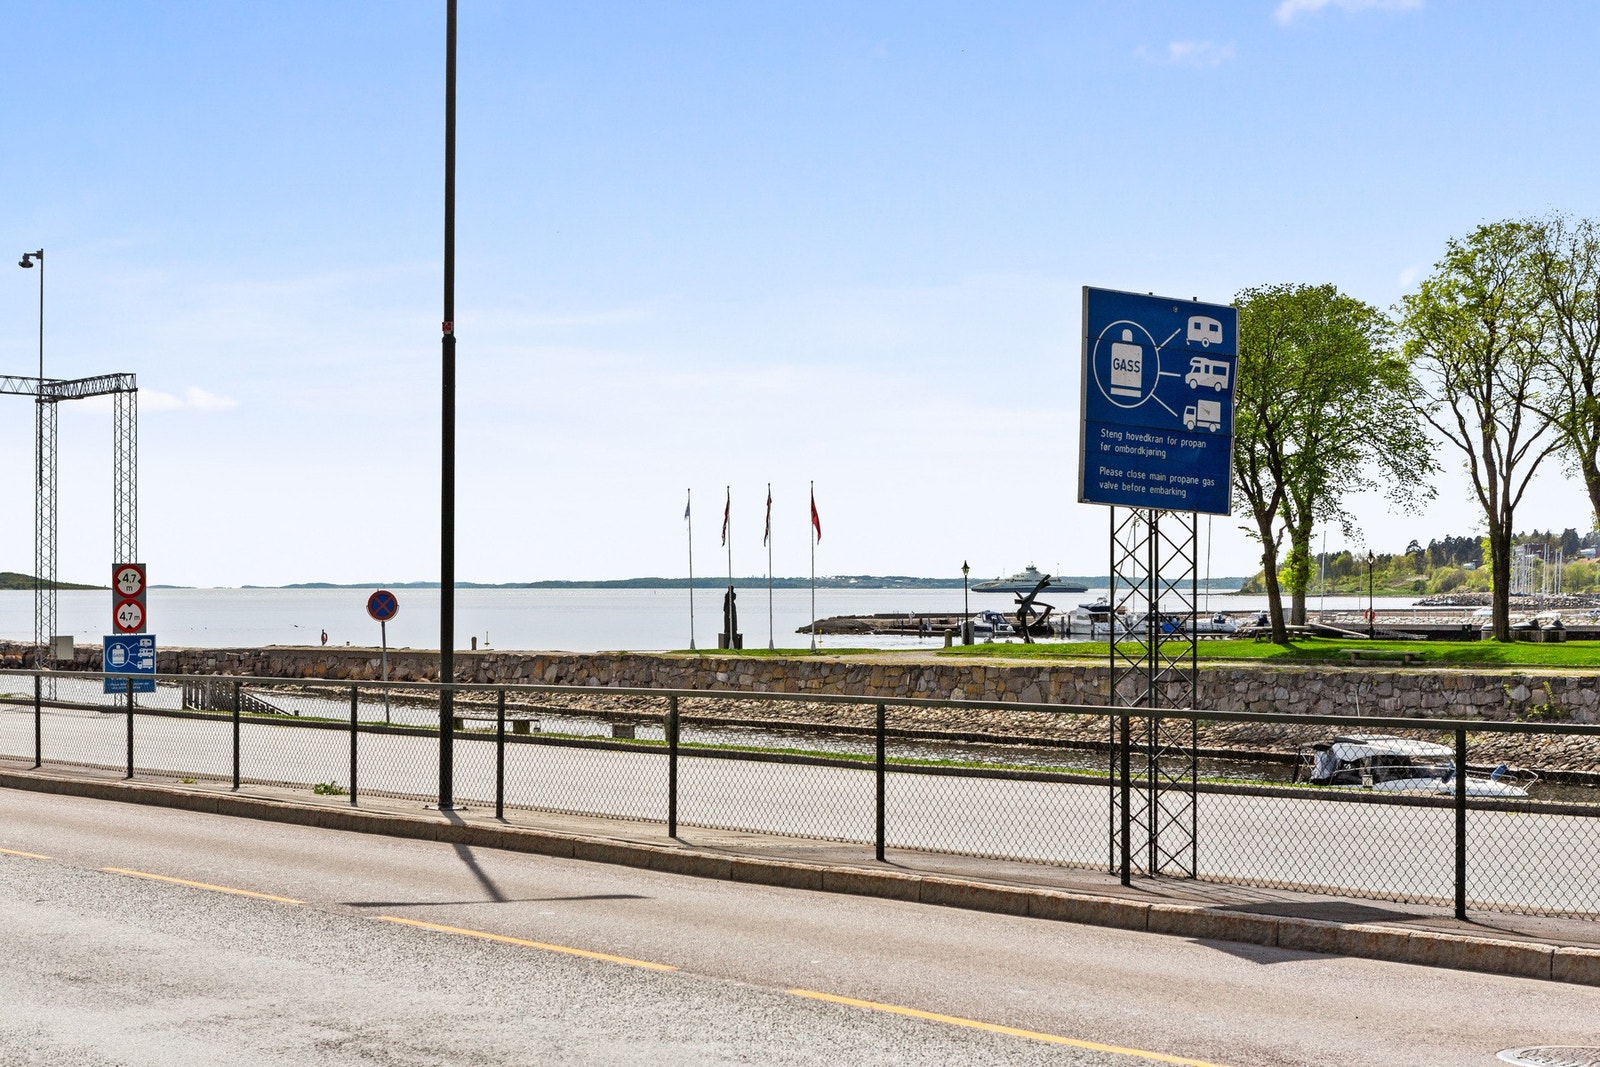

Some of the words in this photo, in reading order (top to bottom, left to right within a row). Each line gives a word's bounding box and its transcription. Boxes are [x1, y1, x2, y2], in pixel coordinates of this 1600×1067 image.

[1113, 358, 1140, 374] GASS
[1100, 428, 1122, 442] Steng
[1126, 430, 1164, 444] hovedkran
[1167, 436, 1178, 445] for
[1180, 439, 1206, 449] propan
[1100, 442, 1110, 452] før
[1114, 444, 1166, 459] ombordkjøring
[1100, 466, 1123, 478] Please
[1126, 469, 1146, 480] close
[1150, 473, 1166, 482] main
[1170, 474, 1199, 486] propane
[1202, 478, 1215, 488] gas
[1099, 481, 1118, 490] valve
[1122, 482, 1146, 493] before
[1150, 486, 1186, 498] embarking
[122, 573, 136, 584] 4,7
[120, 612, 133, 621] 4,7
